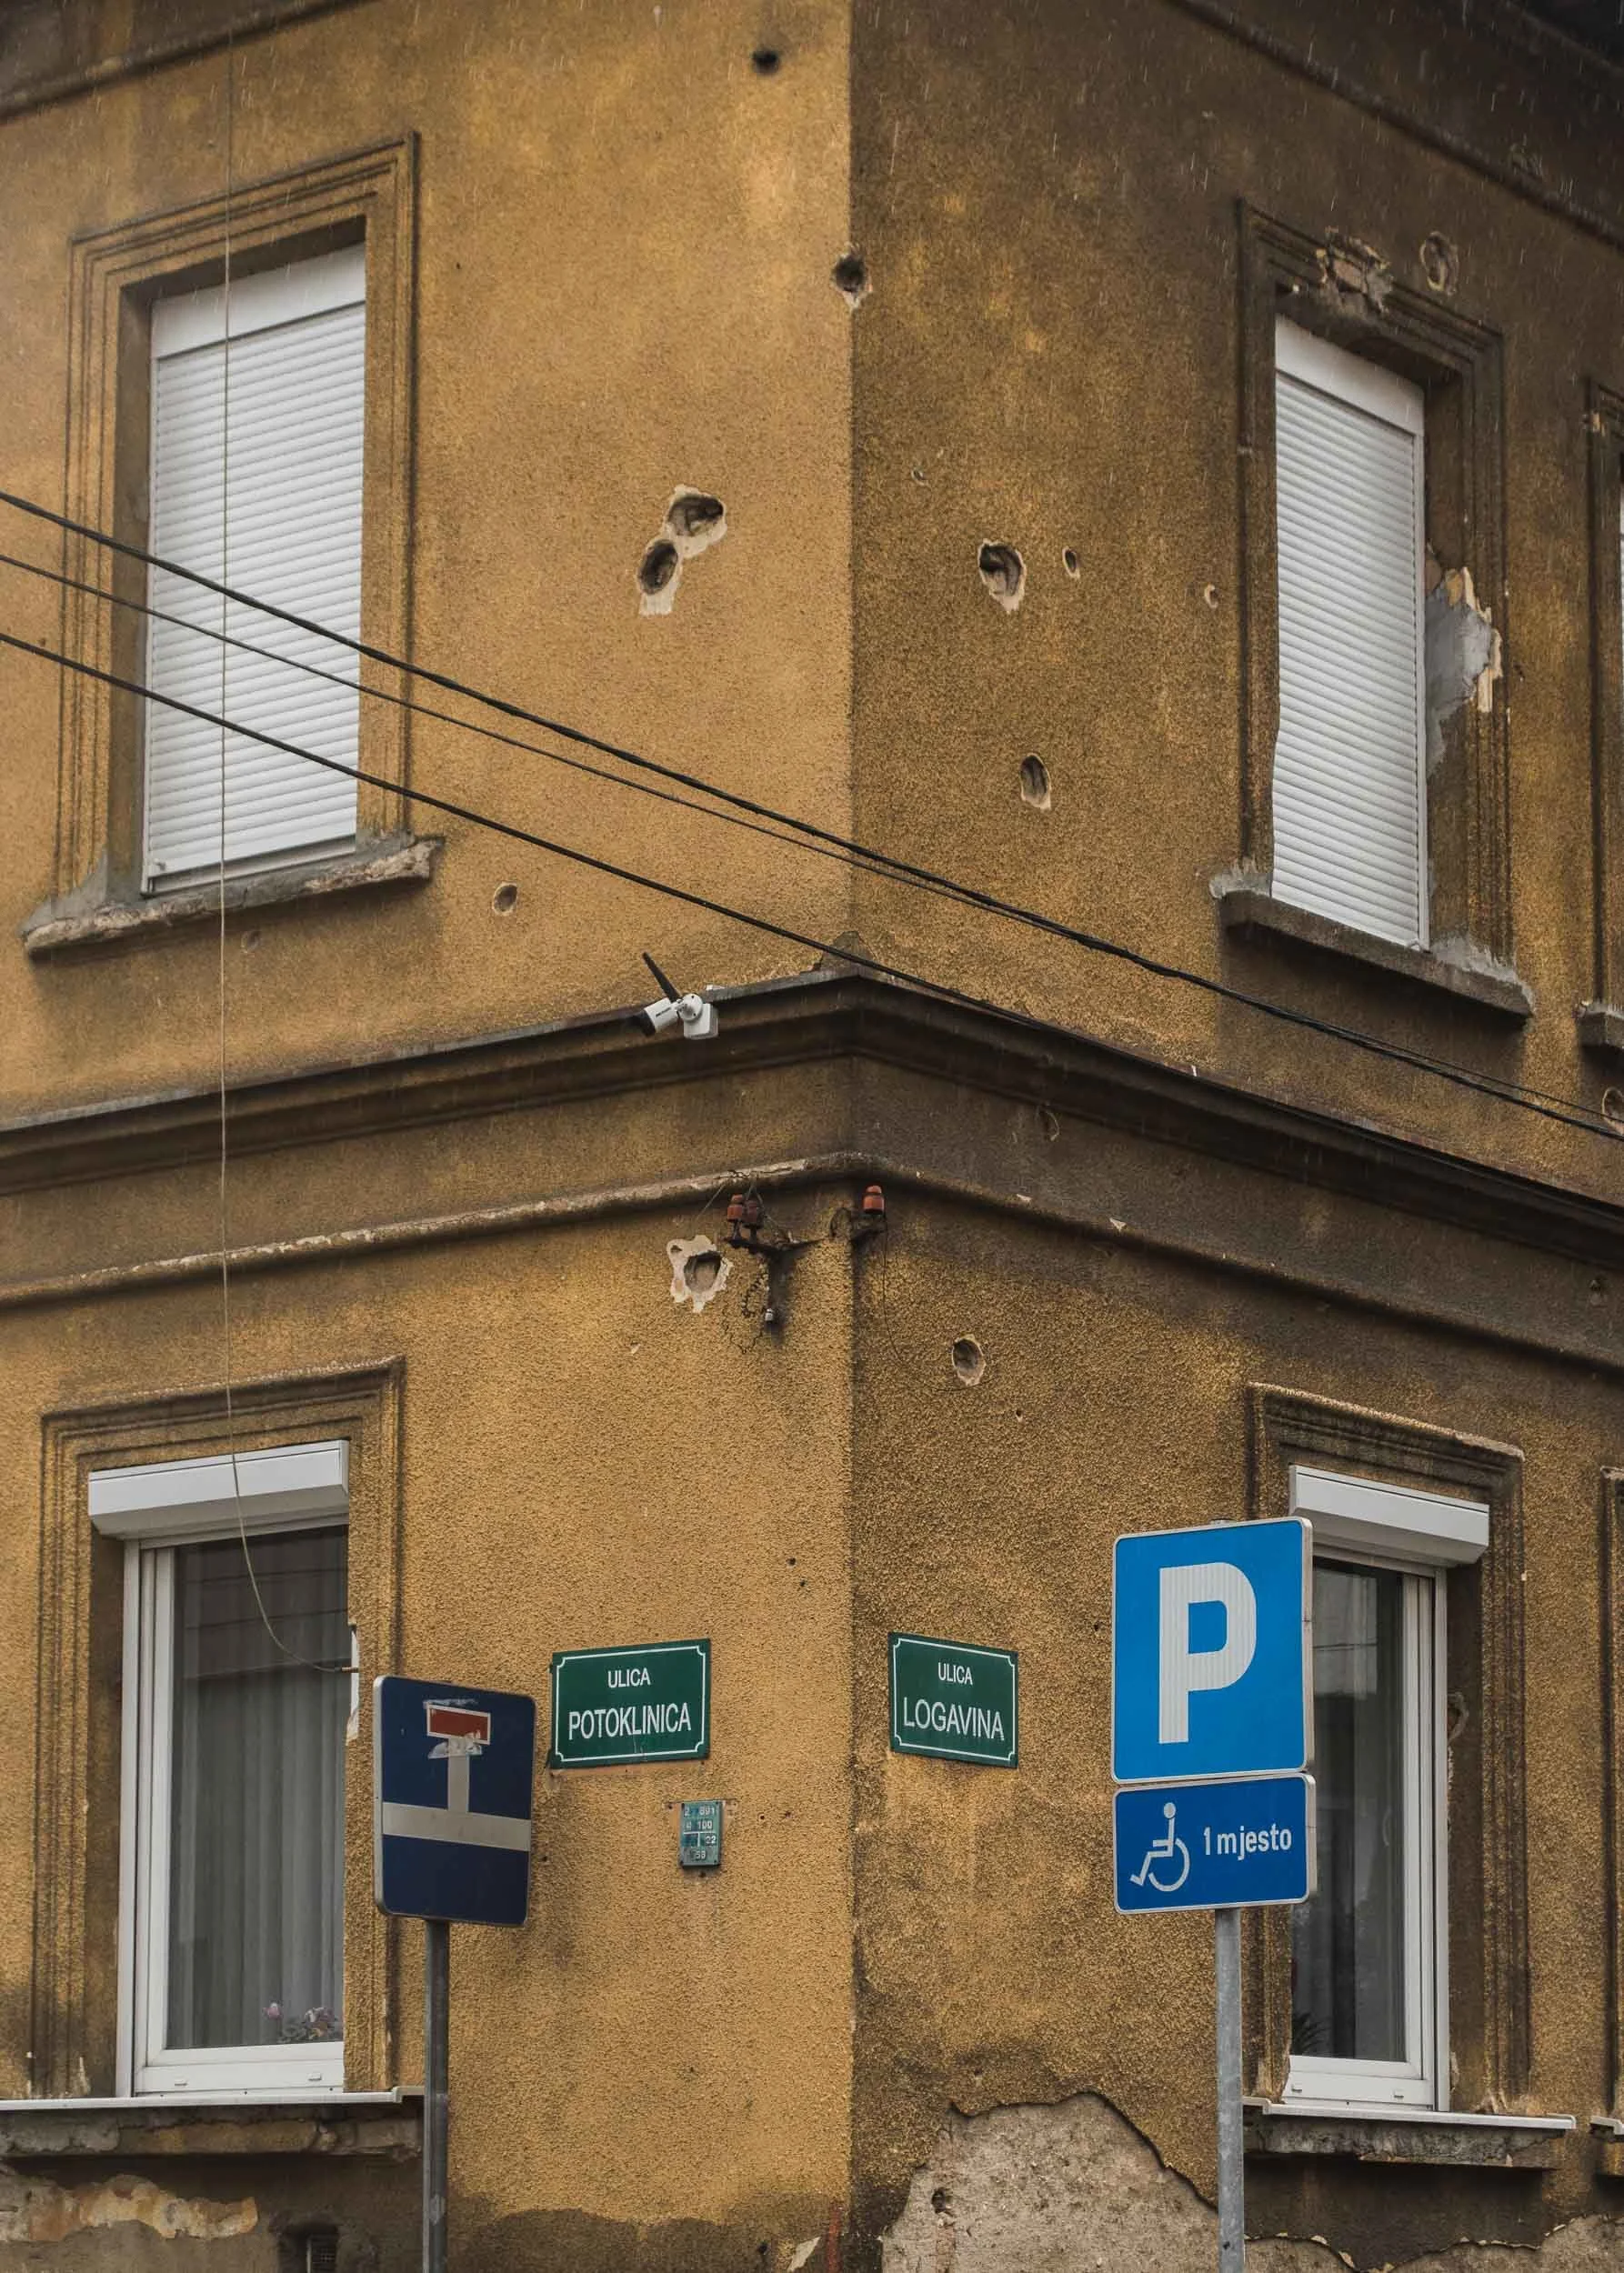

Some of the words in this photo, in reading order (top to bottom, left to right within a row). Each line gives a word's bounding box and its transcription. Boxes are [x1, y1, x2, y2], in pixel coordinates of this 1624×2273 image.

[1158, 1561, 1257, 1744] P
[607, 1667, 651, 1688] ULICA
[937, 1662, 973, 1686] ULICA
[568, 1702, 692, 1741] POTOKLINICA
[903, 1697, 1005, 1741] LOGAVINA
[1203, 1826, 1211, 1856] 1
[1217, 1823, 1292, 1861] mjesto
